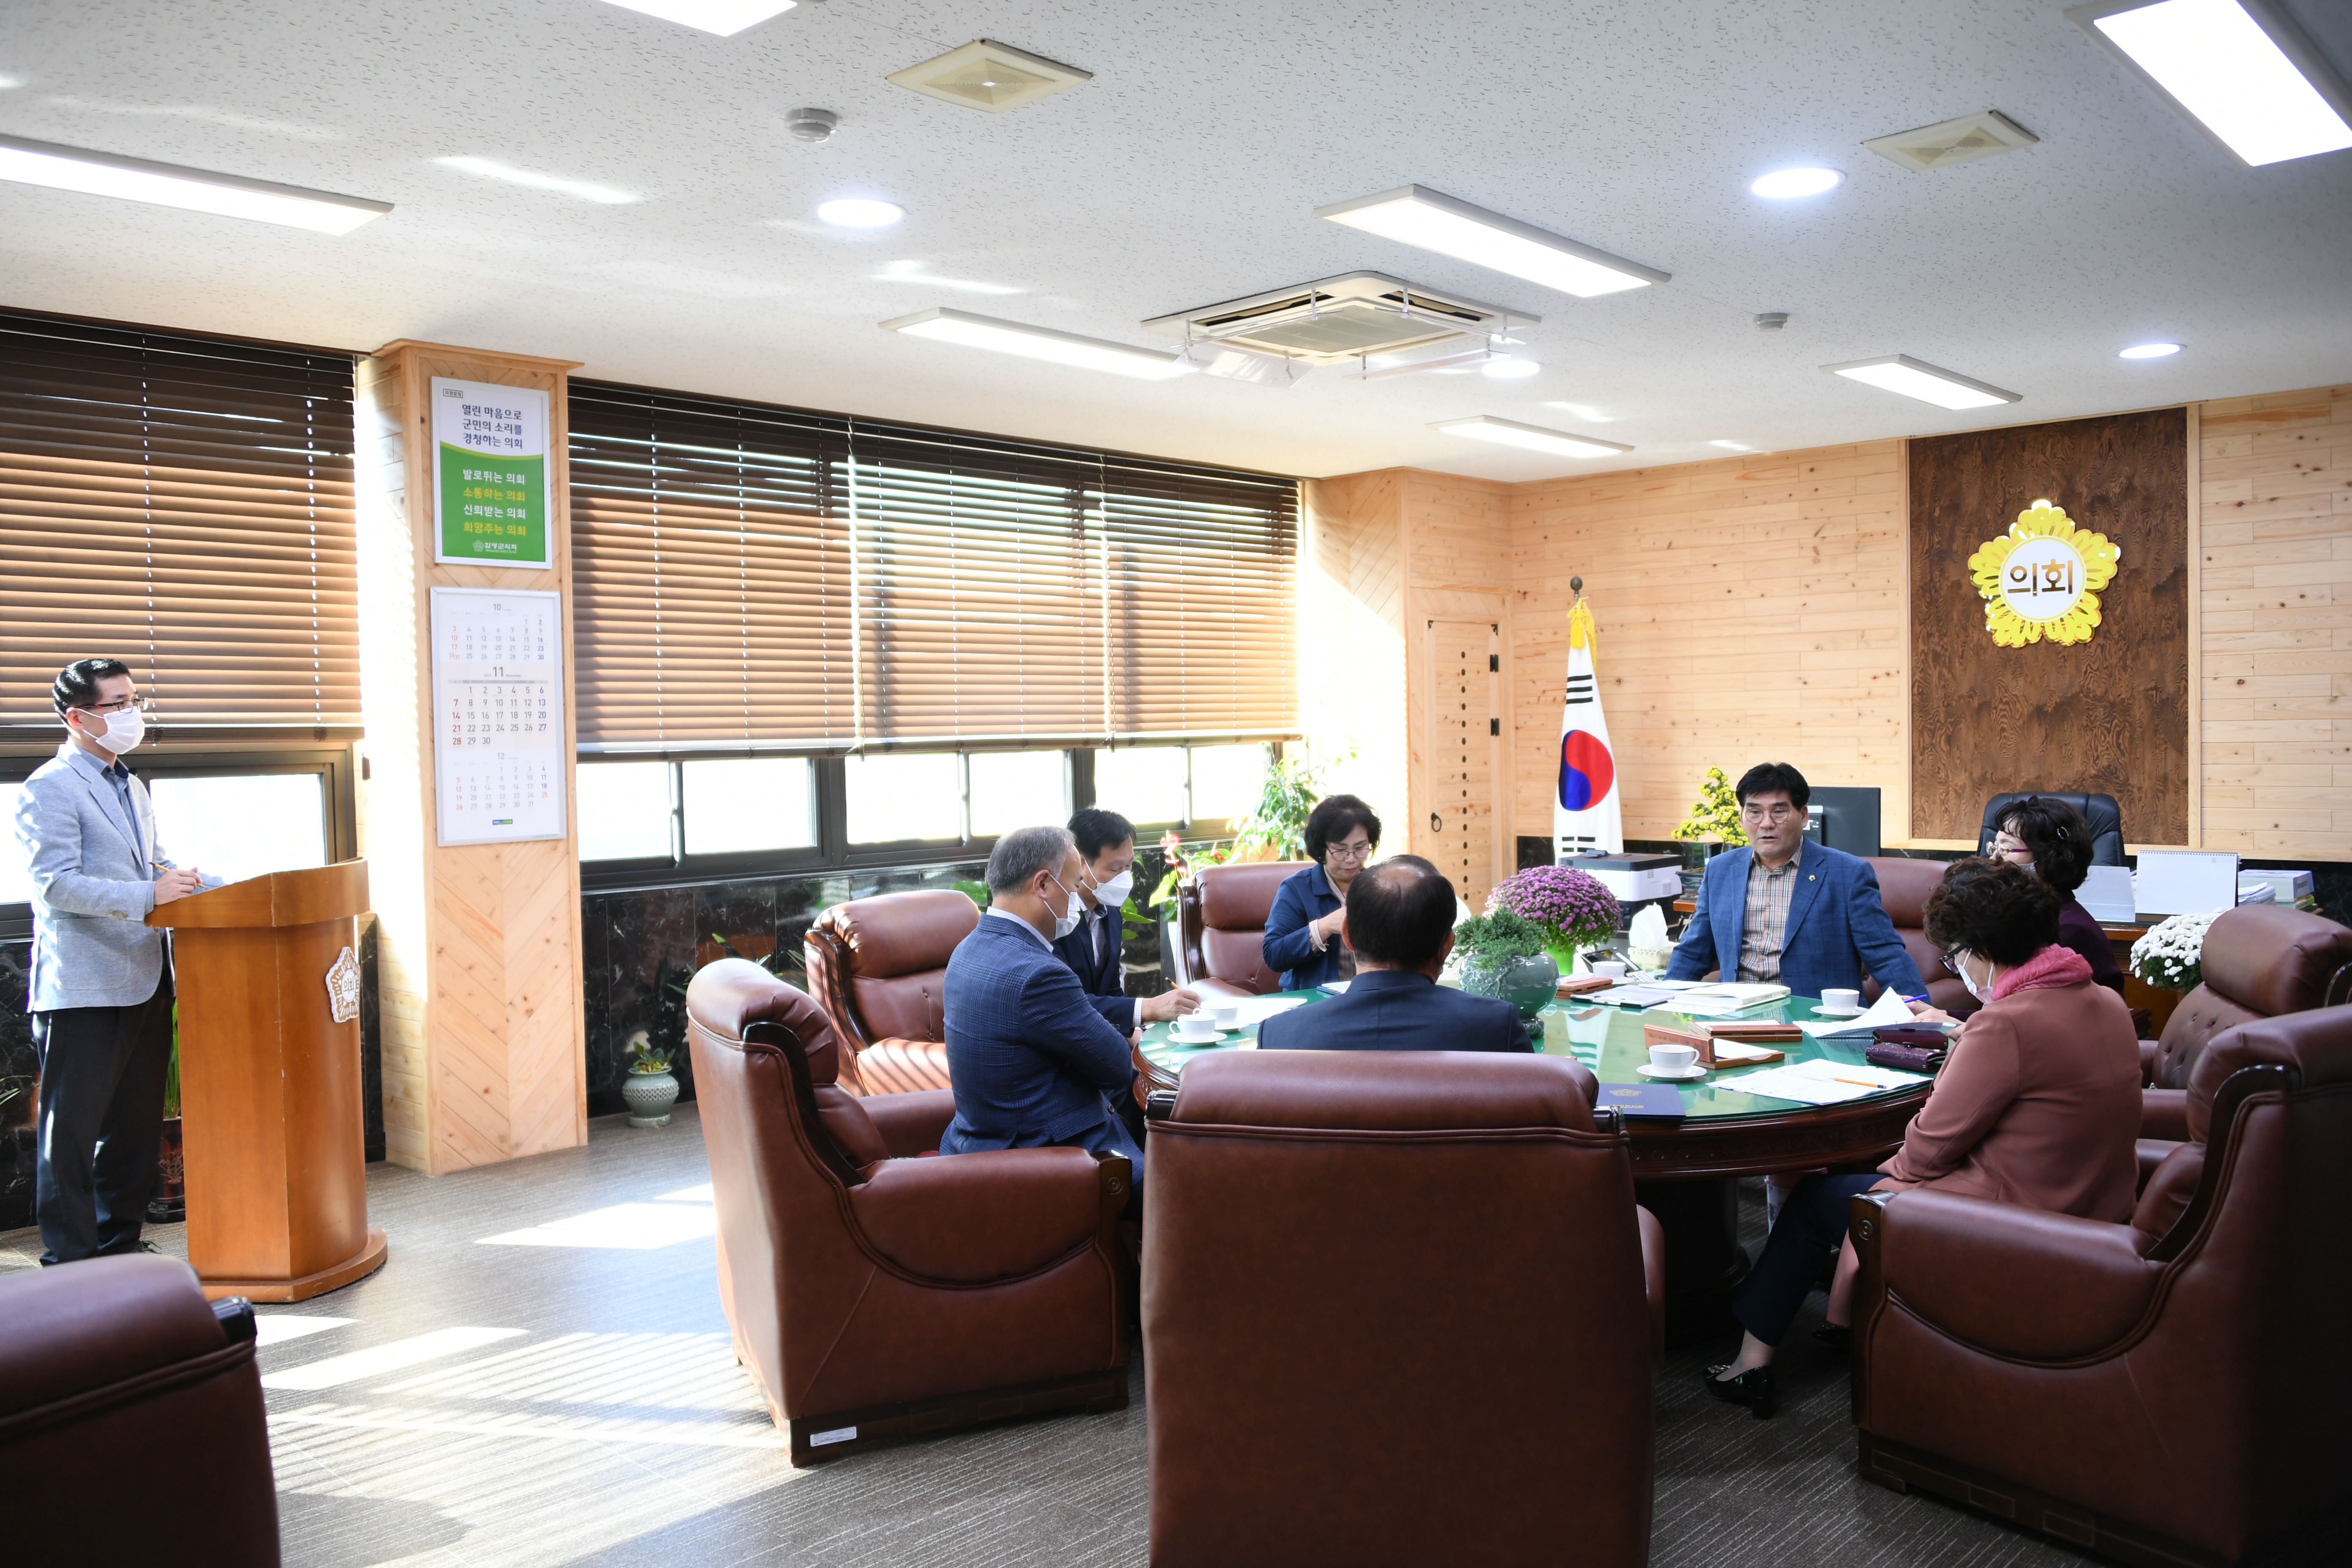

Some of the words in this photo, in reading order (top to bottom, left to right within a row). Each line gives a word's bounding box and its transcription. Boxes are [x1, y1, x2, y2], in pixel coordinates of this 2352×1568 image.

[462, 404, 481, 417] 열린
[484, 407, 522, 420] 마음으로
[463, 419, 491, 432] 군민의
[494, 422, 522, 436] 소리를
[463, 433, 501, 447] 경청하는
[504, 438, 523, 449] 의회
[463, 469, 503, 483] 발로뛰는
[506, 473, 525, 485] 의회
[463, 487, 503, 500] 소통하는
[506, 490, 525, 502] 의회
[464, 504, 503, 518] 신뢰받는
[506, 508, 525, 519] 의회
[464, 522, 503, 535] 희망주는
[507, 525, 525, 536] 의회
[2007, 559, 2073, 597] 의회
[493, 667, 504, 677] 11
[483, 686, 487, 694] 2
[497, 686, 502, 694] 3
[525, 686, 530, 694] 5
[454, 699, 458, 707] 7
[468, 699, 473, 707] 8
[467, 711, 475, 719] 15
[482, 711, 490, 719] 16
[538, 711, 547, 719] 20
[452, 724, 460, 732] 21
[482, 724, 490, 732] 23
[510, 724, 519, 732] 25
[538, 723, 547, 731] 27
[452, 737, 461, 745] 28
[343, 976, 354, 994] 의회
